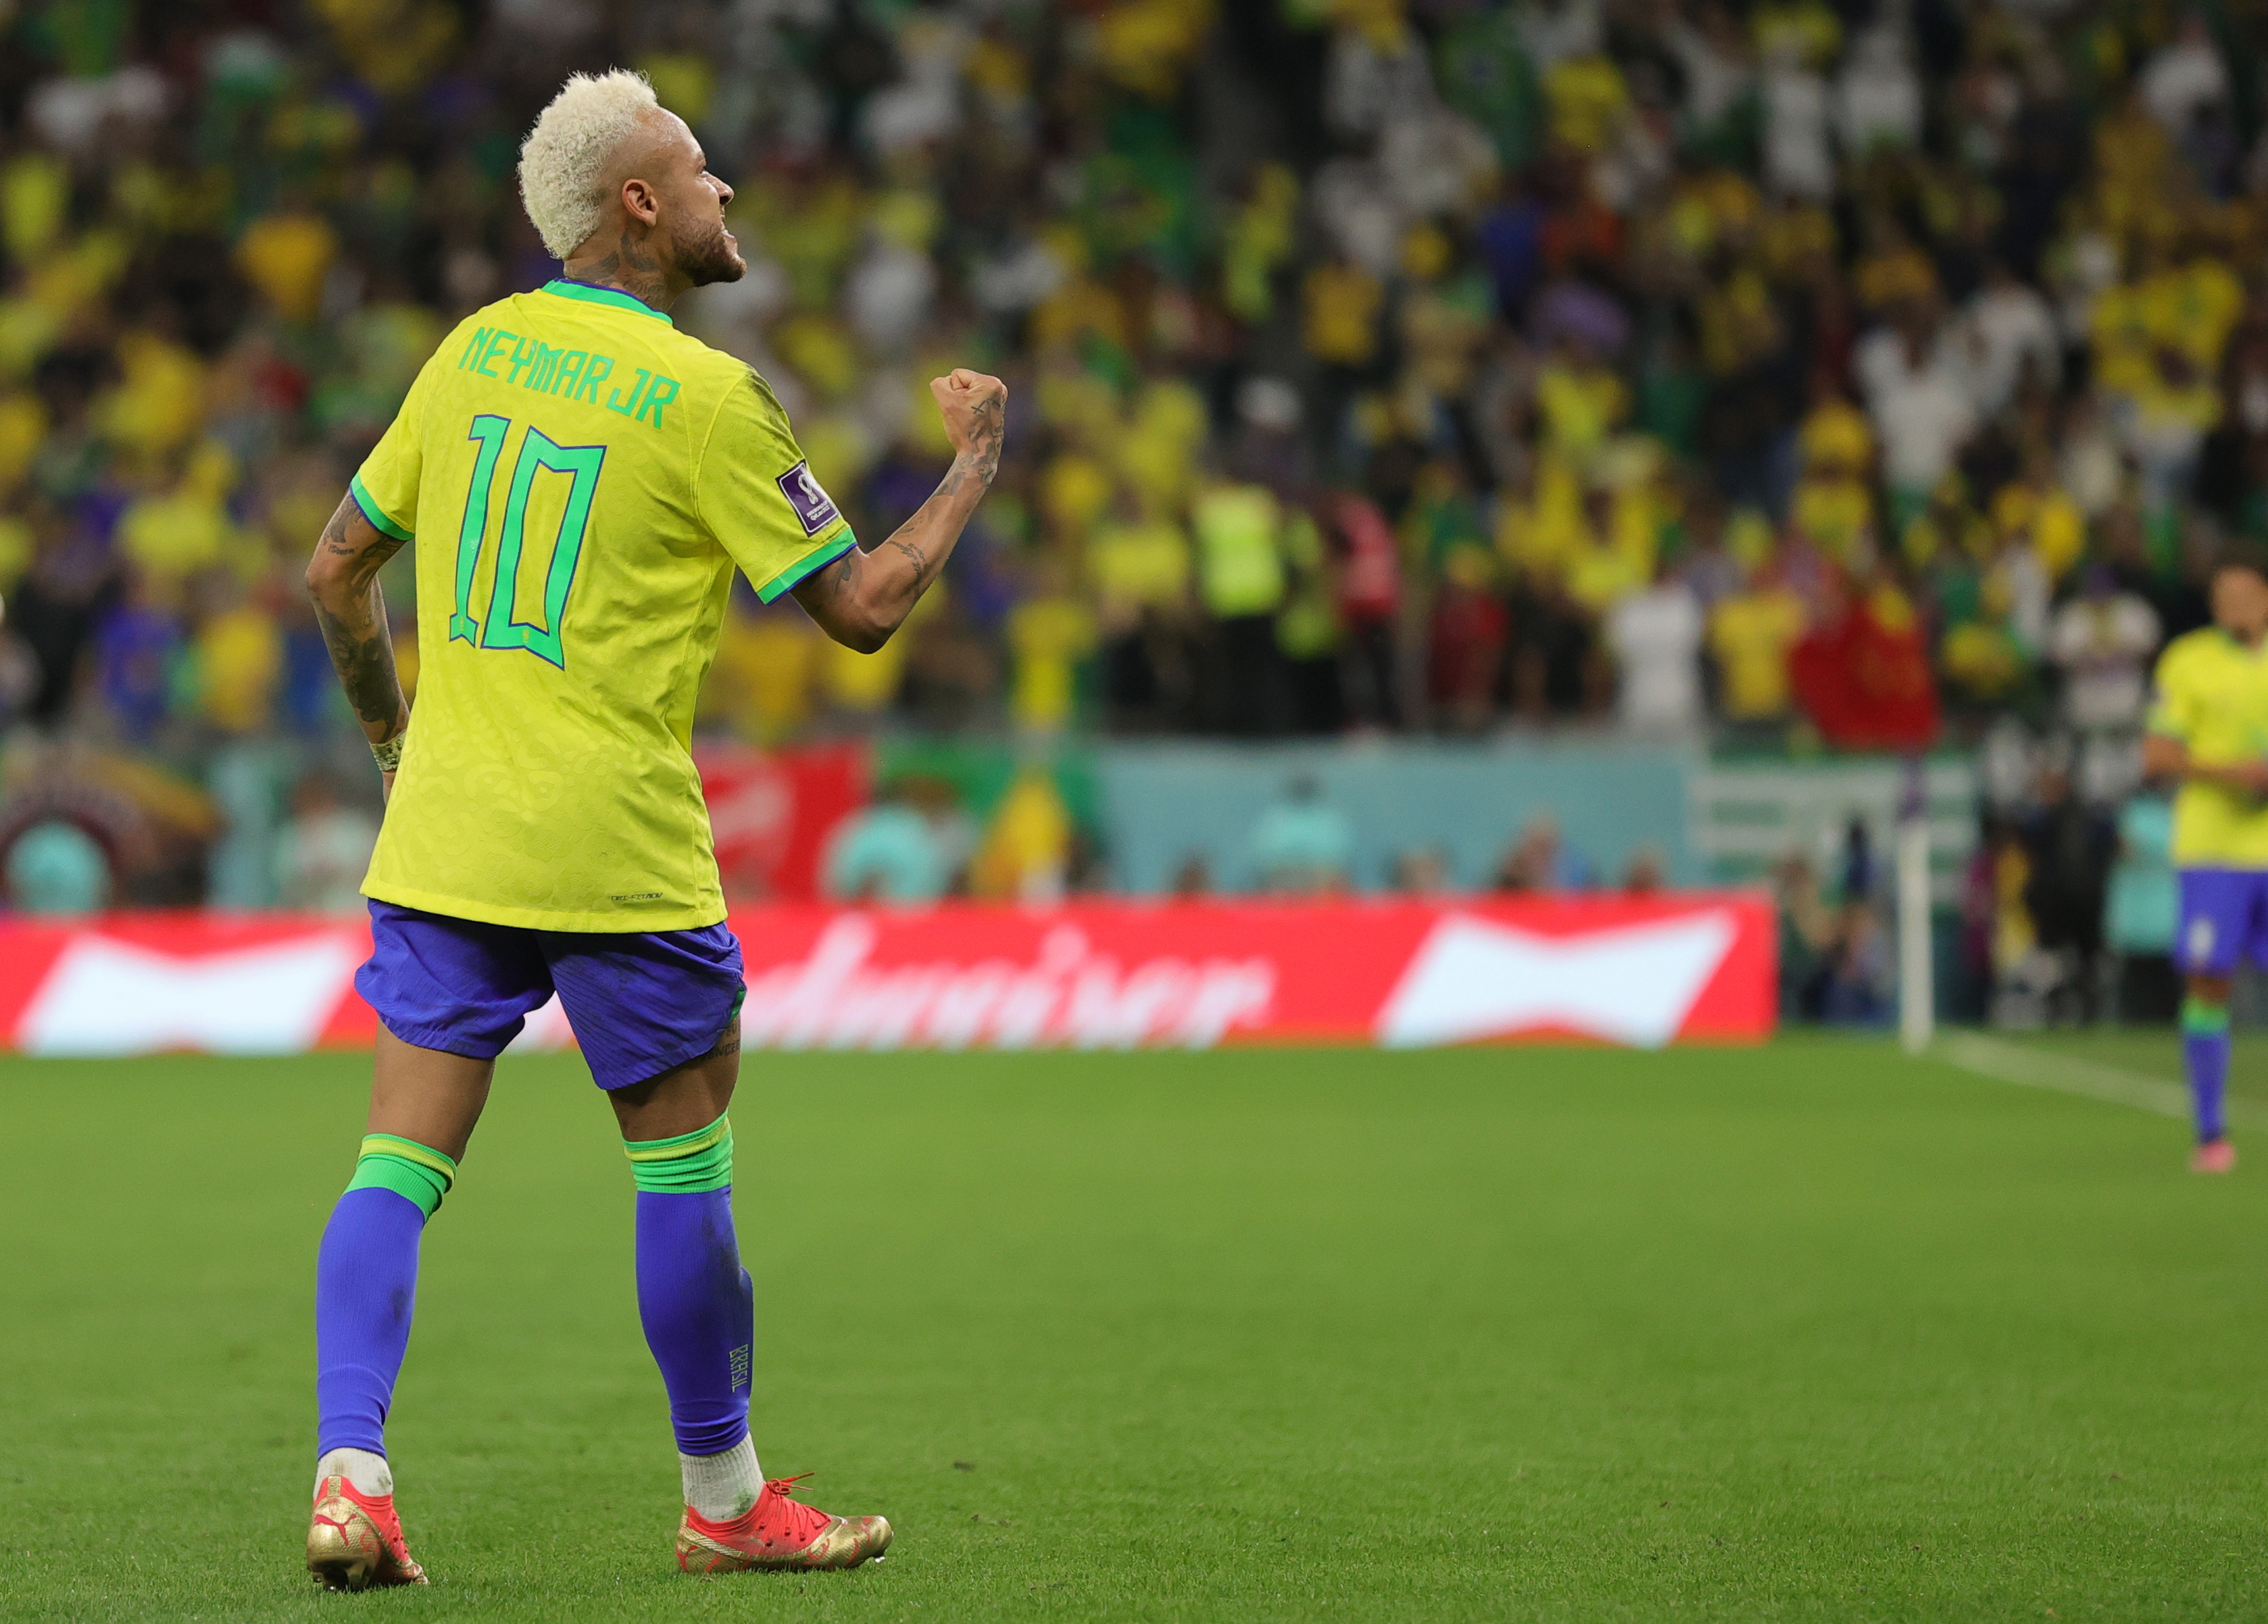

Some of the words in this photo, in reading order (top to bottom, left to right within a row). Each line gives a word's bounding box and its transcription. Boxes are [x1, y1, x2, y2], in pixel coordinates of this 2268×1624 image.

[458, 326, 614, 404] NEYMAR
[606, 368, 681, 428] JR
[449, 414, 607, 671] 10
[514, 912, 1276, 1050] dweiser
[729, 1344, 749, 1394] BRASIL
